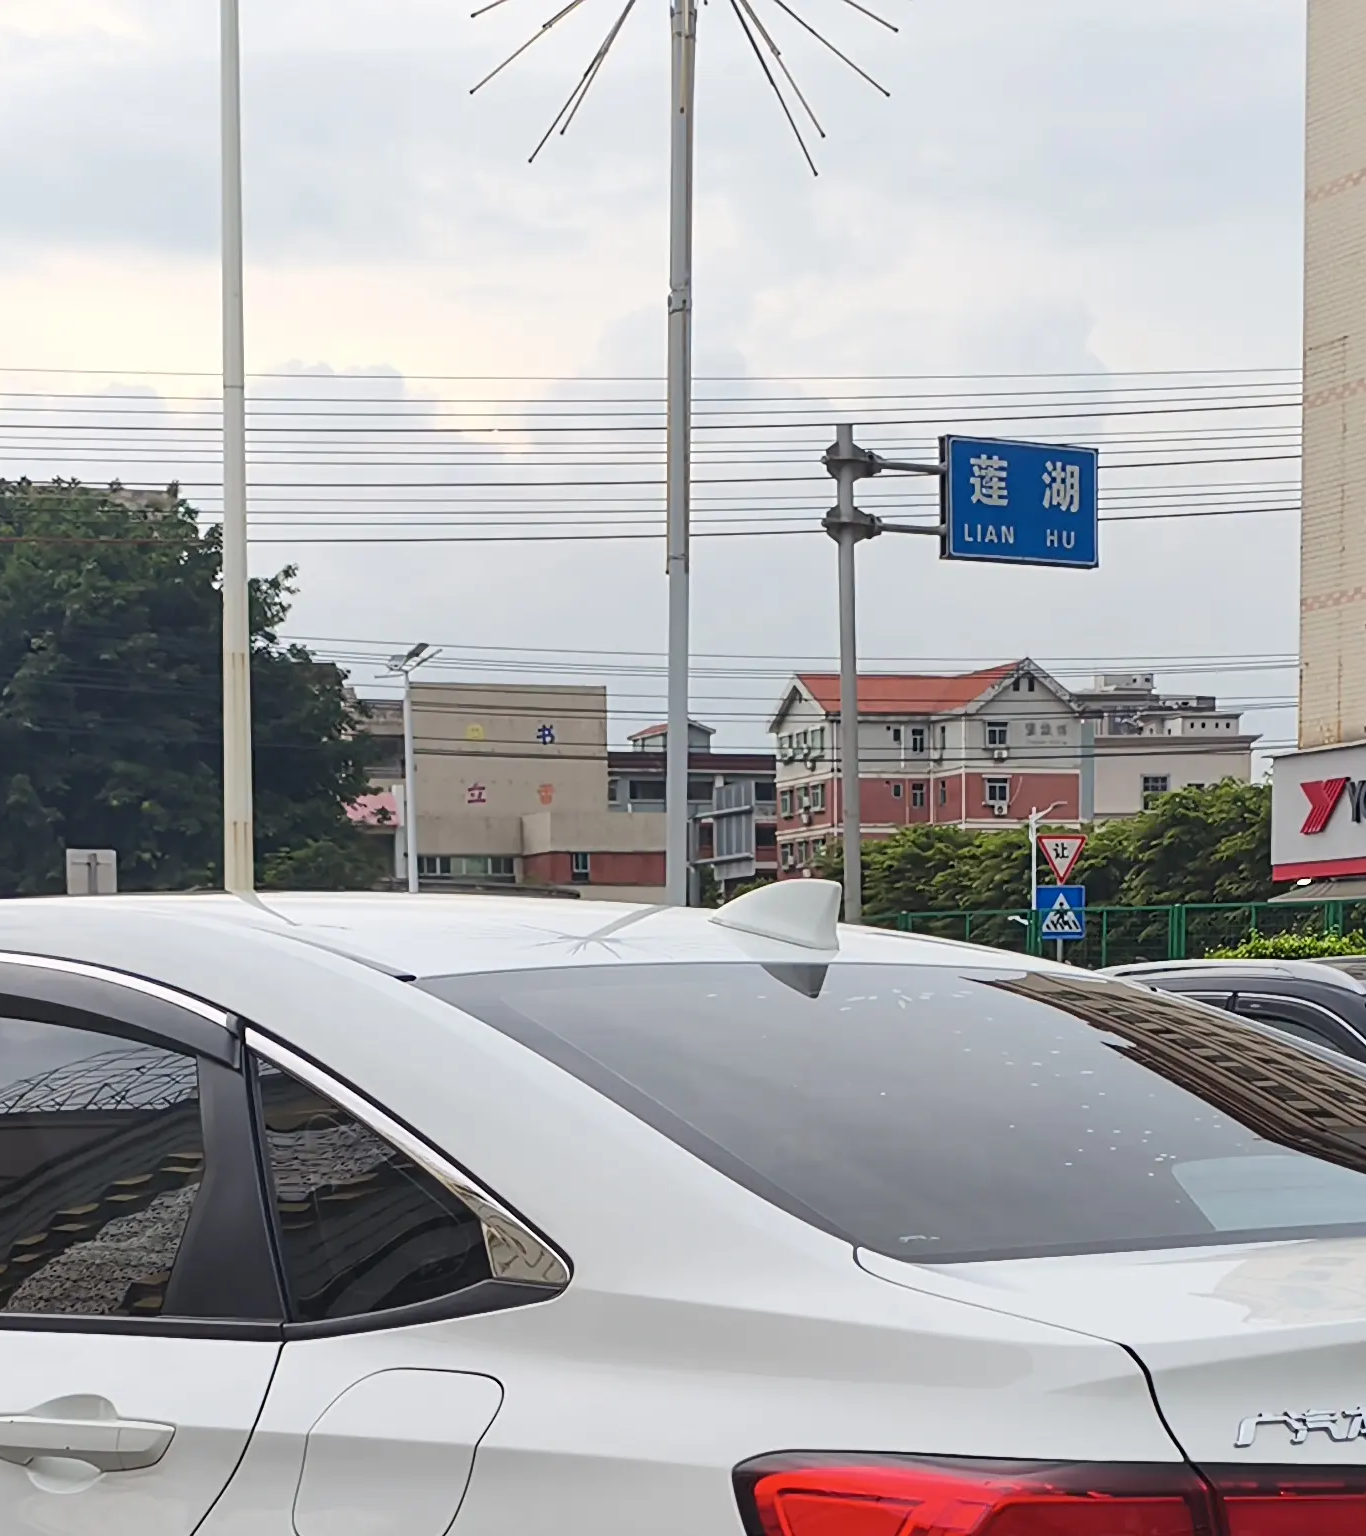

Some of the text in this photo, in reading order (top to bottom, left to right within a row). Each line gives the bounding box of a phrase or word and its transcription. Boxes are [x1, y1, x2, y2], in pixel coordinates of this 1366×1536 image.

[969, 454, 1080, 513] 莲湖
[963, 523, 1076, 549] LIAN HU
[1053, 842, 1069, 859] 让
